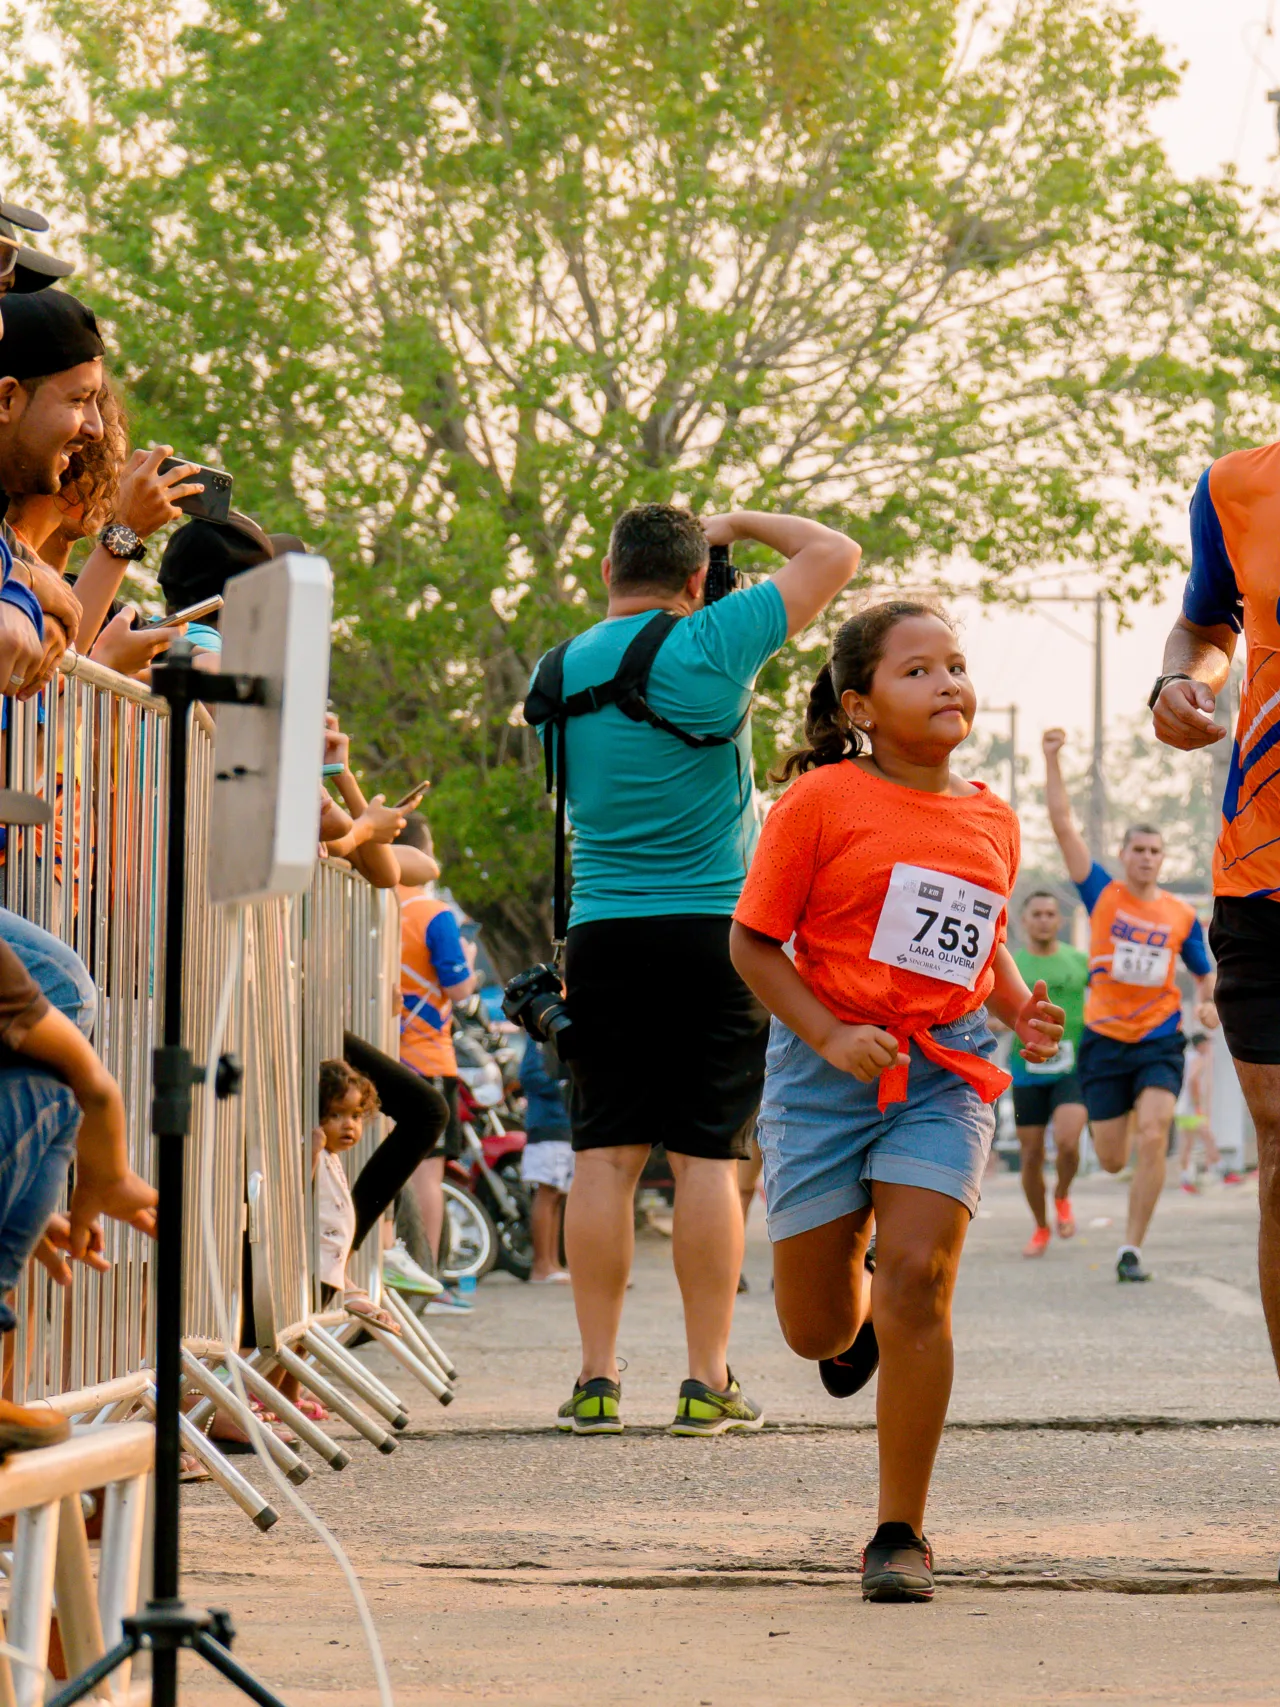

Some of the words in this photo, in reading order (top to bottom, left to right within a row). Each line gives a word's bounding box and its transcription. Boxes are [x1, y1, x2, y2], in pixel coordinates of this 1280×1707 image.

[912, 907, 980, 959] 753
[909, 943, 935, 958] LARA
[938, 951, 975, 971] OLIVEIRA
[909, 957, 941, 972] SINOBRAS
